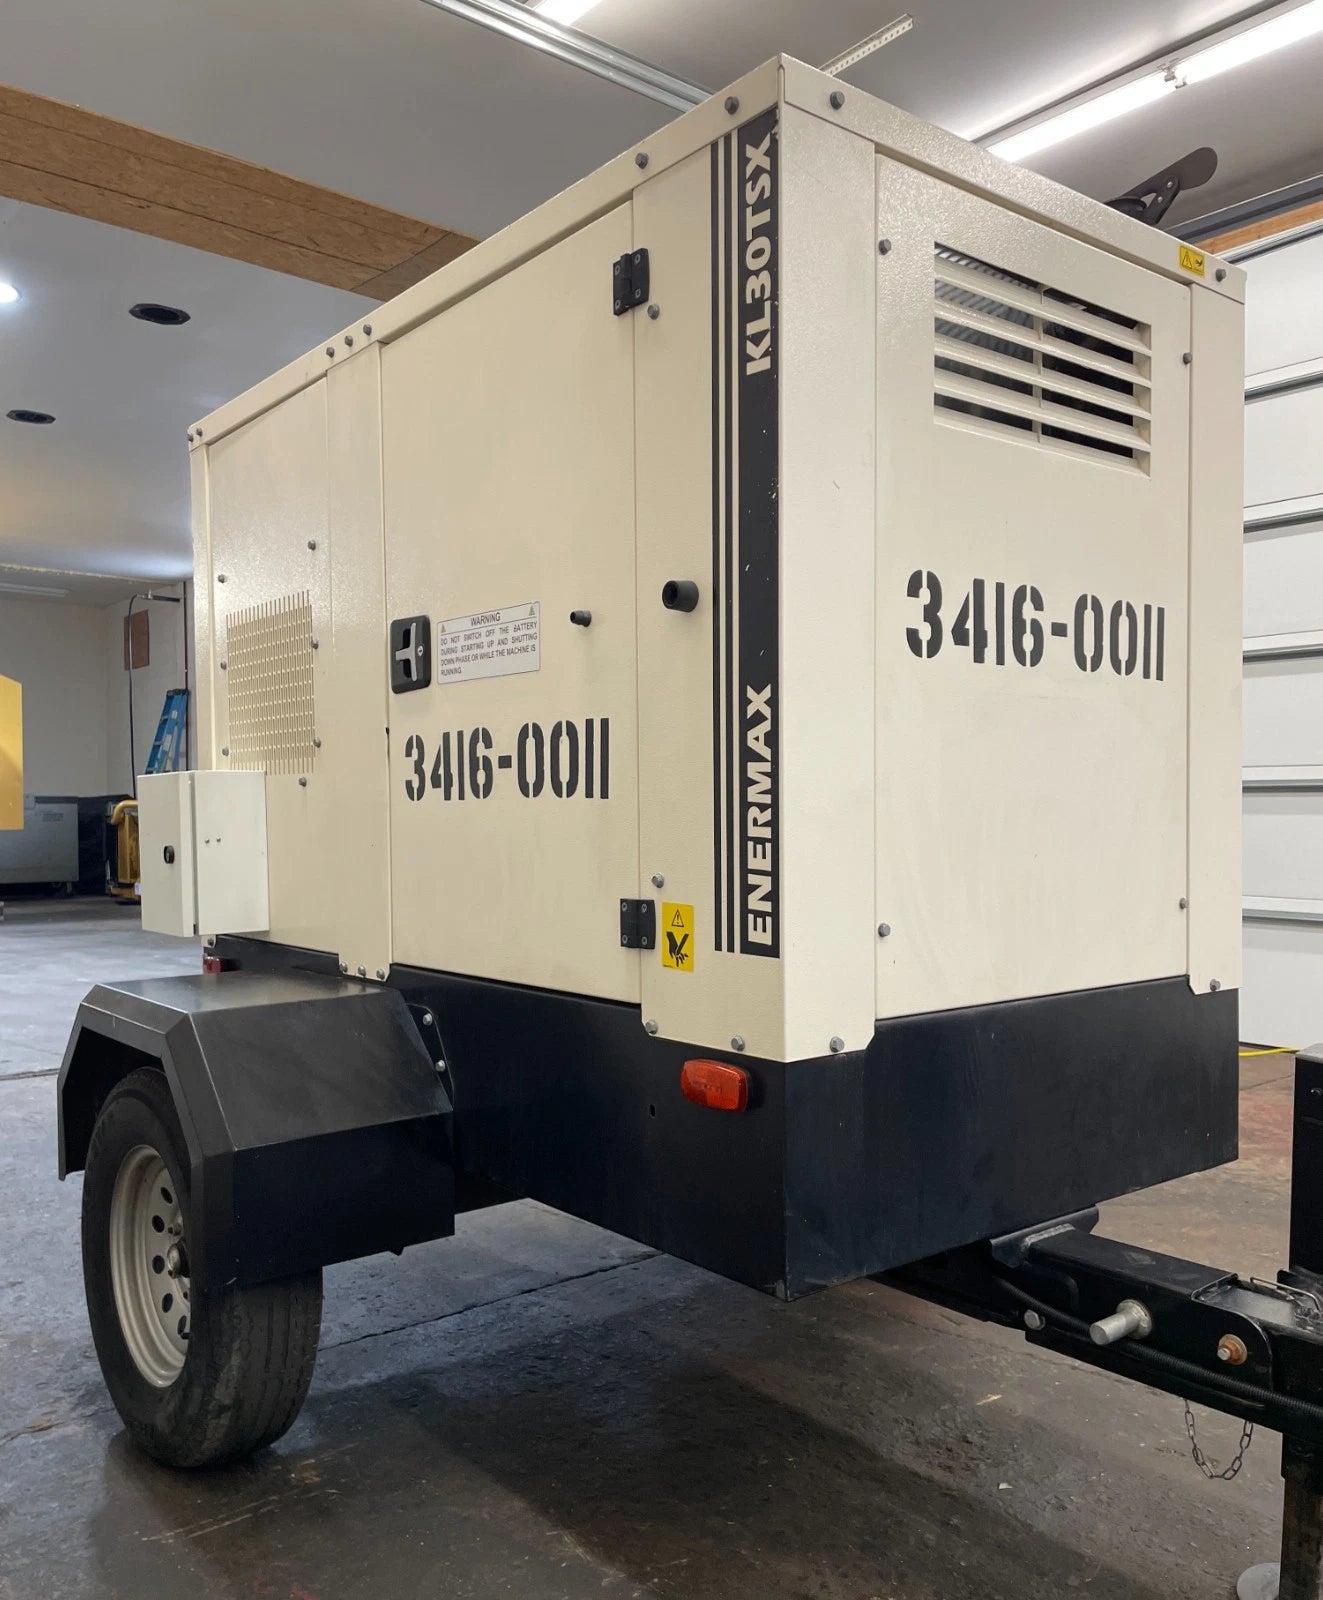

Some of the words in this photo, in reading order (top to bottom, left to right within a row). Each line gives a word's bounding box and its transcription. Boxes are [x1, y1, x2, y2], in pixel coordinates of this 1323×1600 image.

[745, 131, 771, 376] KL30TSX
[441, 647, 458, 655] DURING
[461, 642, 484, 652] STARTING
[512, 633, 538, 643] SHUTTING
[465, 632, 482, 641] SWITCH
[486, 629, 494, 637] OFF
[514, 622, 536, 632] BATTERY
[471, 613, 500, 626] WARNING
[906, 569, 1166, 682] 3416-0011
[456, 655, 470, 663] PHASE
[480, 651, 494, 659] WHILE
[507, 646, 530, 655] MACHINE
[405, 717, 609, 802] 3416-0011
[747, 683, 772, 946] ENERMAX
